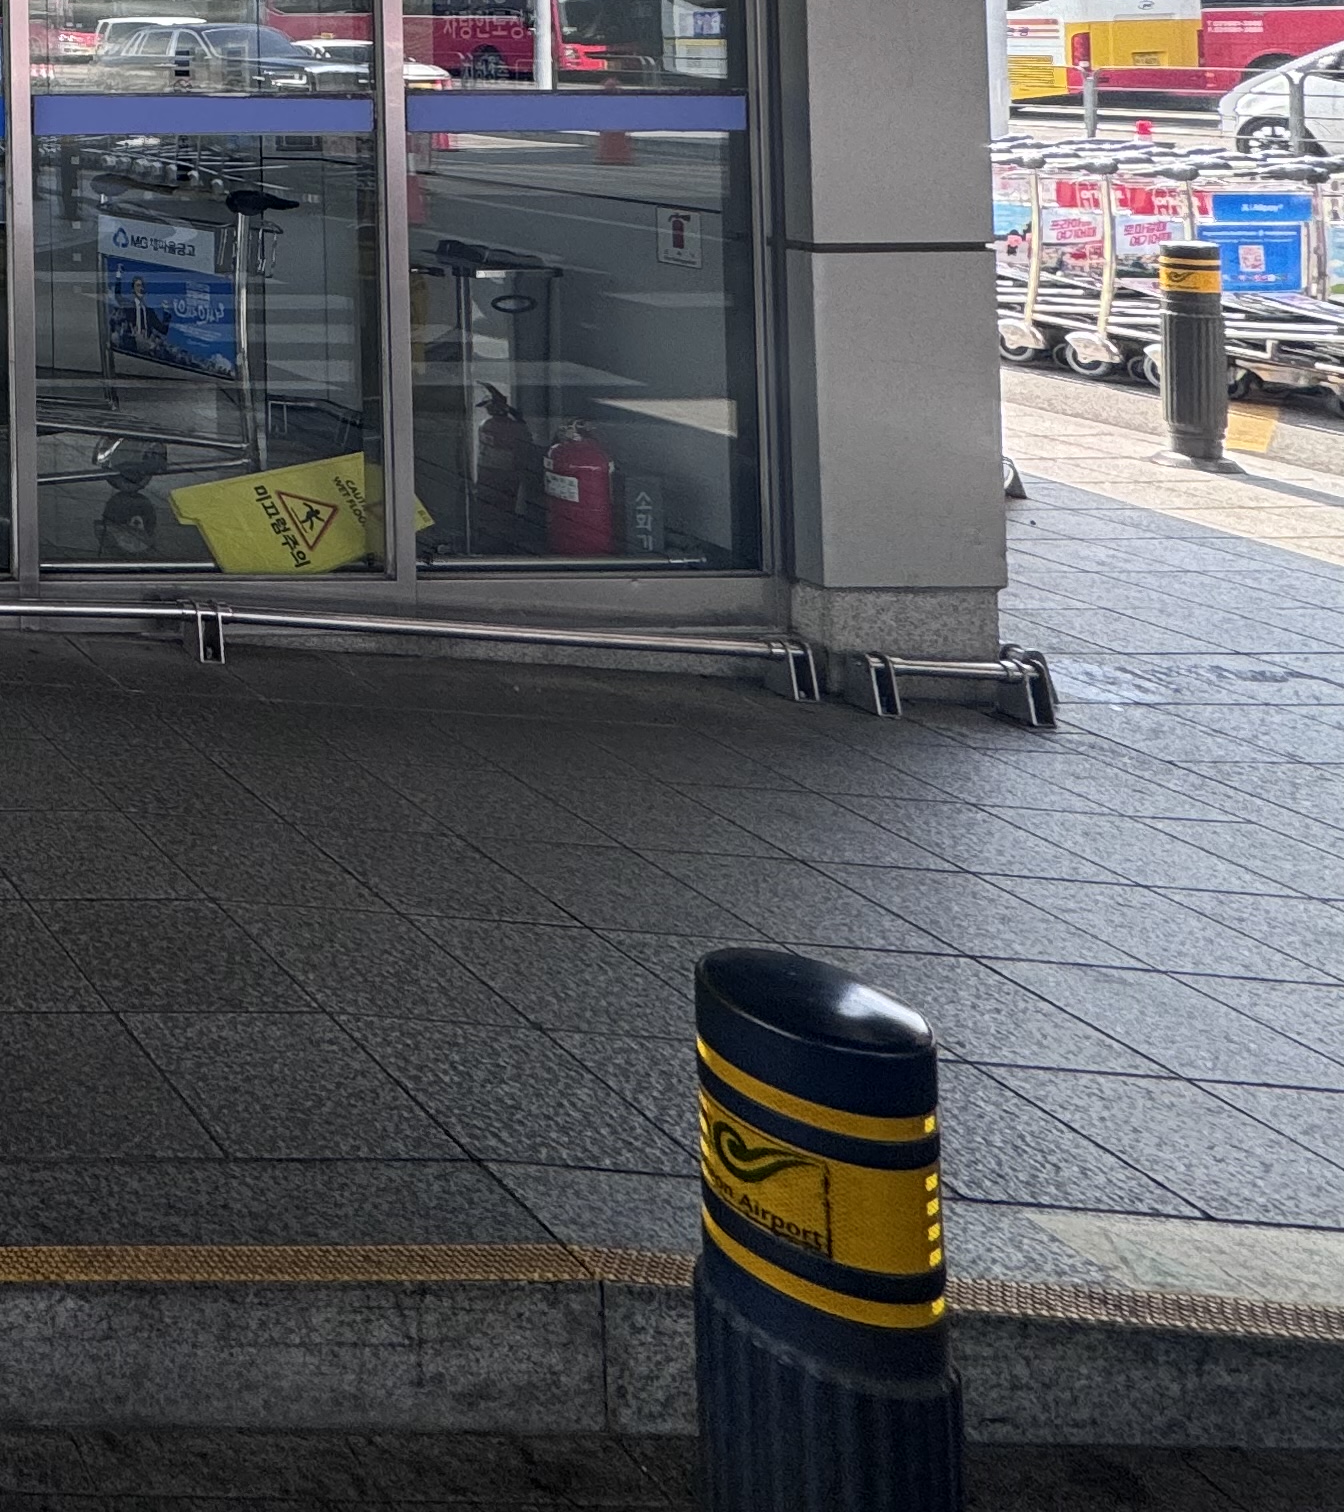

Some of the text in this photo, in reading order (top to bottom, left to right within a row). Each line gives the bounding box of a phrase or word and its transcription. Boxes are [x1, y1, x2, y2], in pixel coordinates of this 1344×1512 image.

[442, 8, 534, 39] 차량인도장
[130, 234, 149, 250] MG
[253, 484, 312, 568] 미끄럼주의
[332, 475, 367, 527] WET FLOO
[634, 490, 654, 552] 소화기
[738, 1191, 824, 1245] Airport
